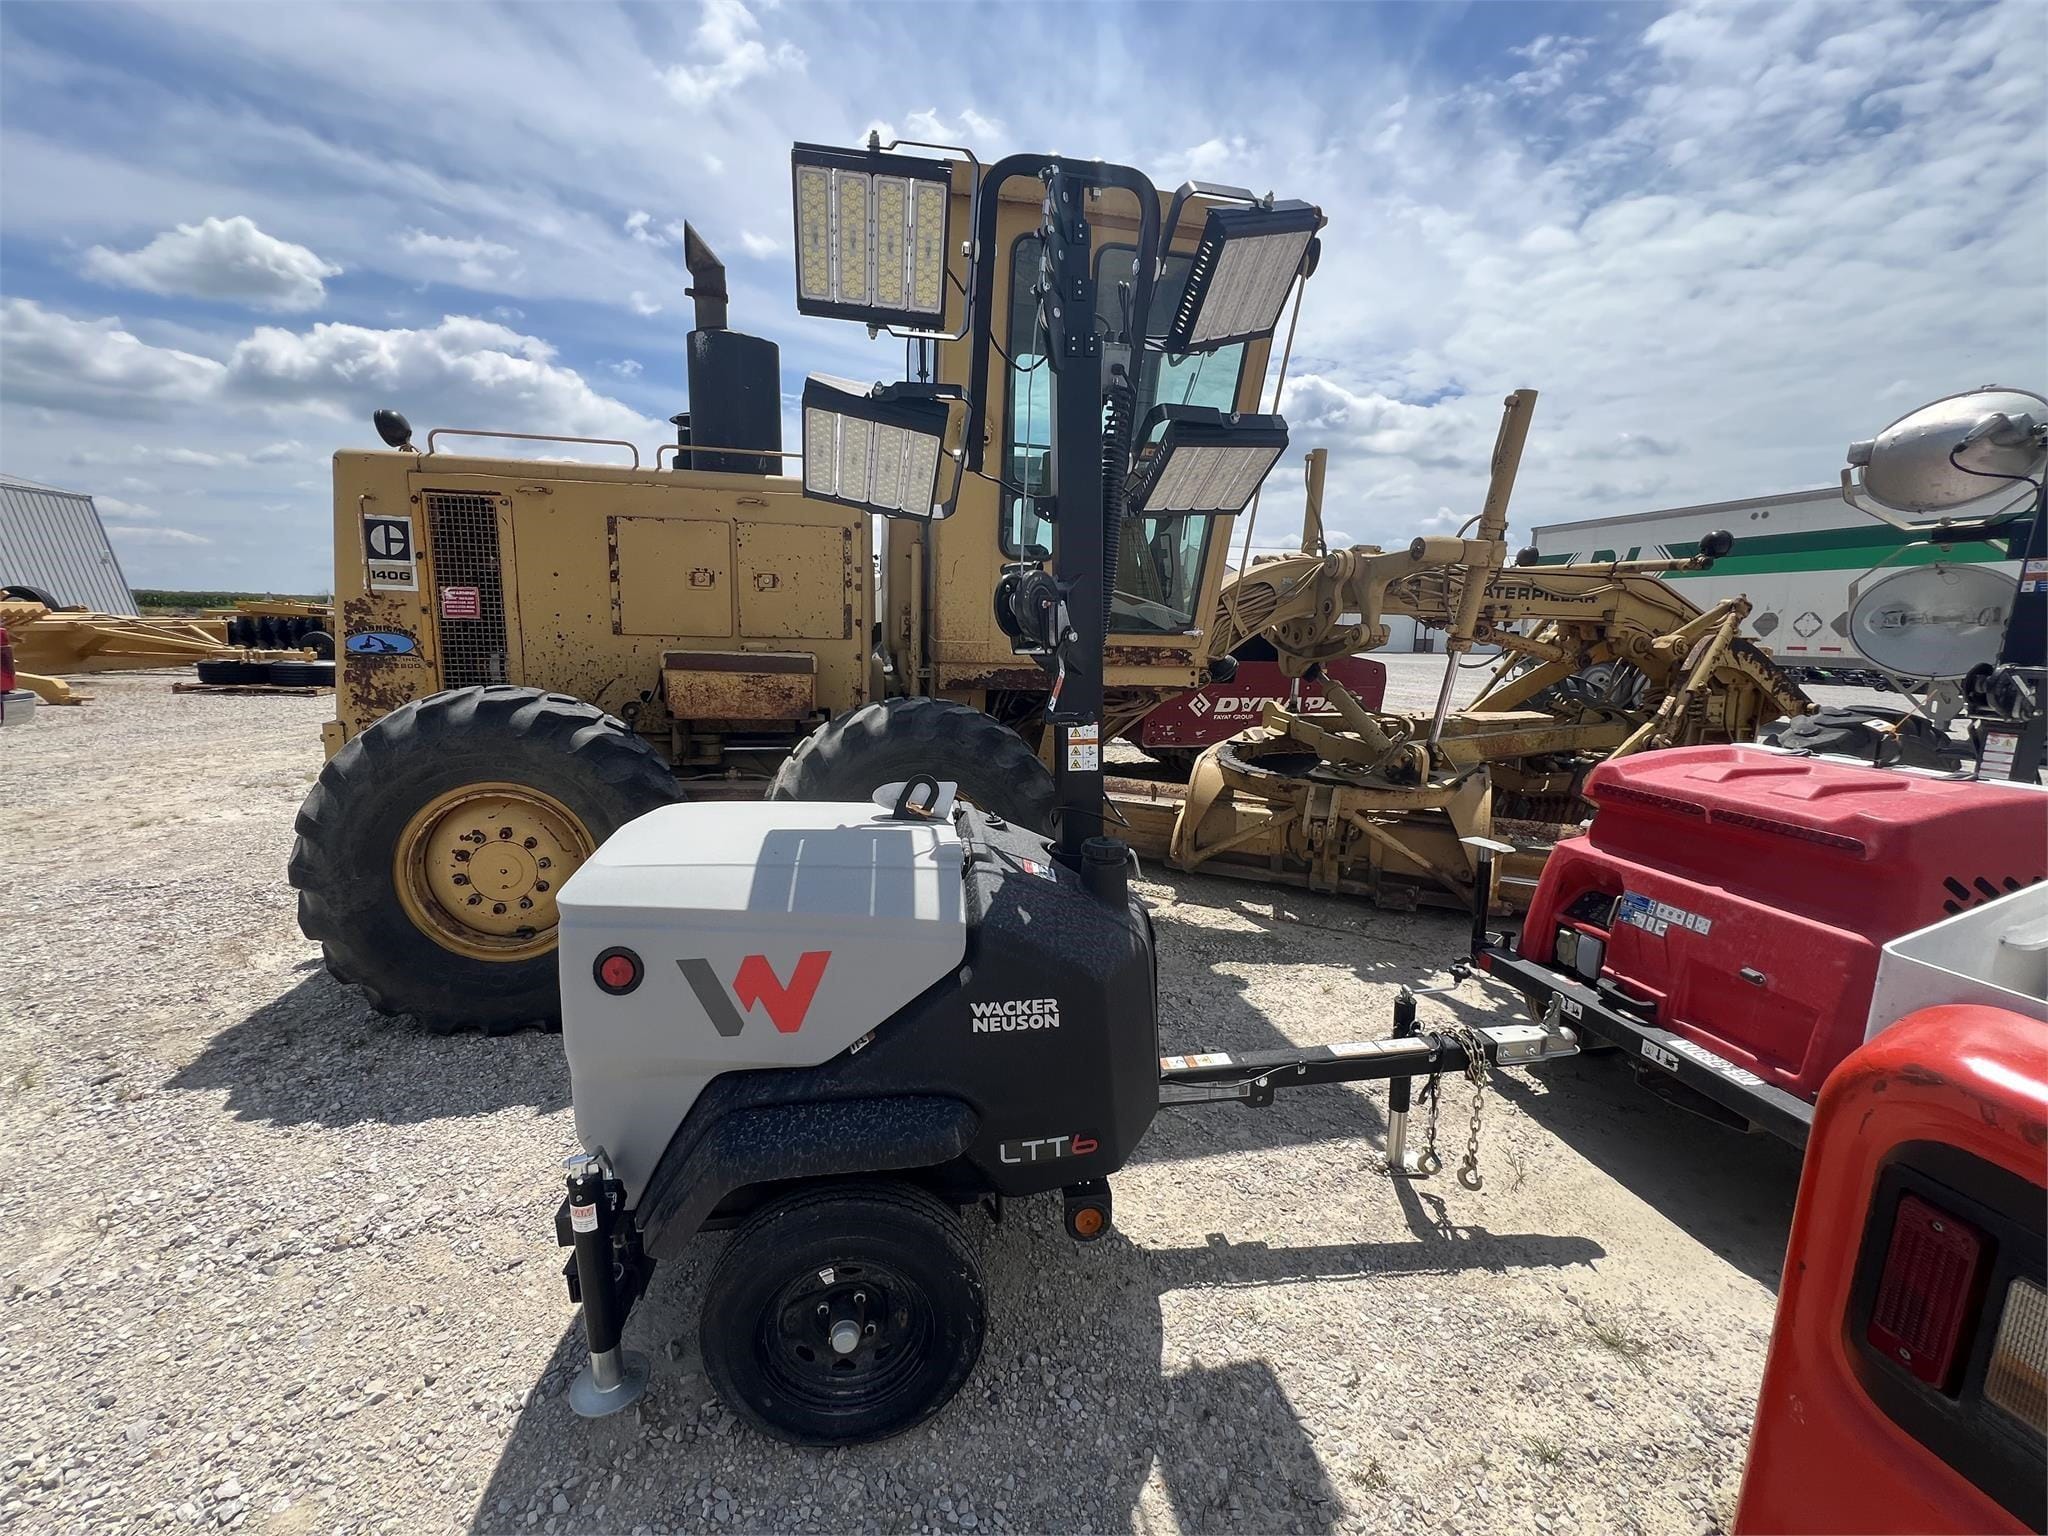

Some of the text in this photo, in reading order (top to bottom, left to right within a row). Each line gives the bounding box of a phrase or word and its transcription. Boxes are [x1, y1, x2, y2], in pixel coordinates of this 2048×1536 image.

[371, 570, 411, 581] 140G
[970, 999, 1060, 1017] WACKER
[972, 1013, 1060, 1033] NEUSON
